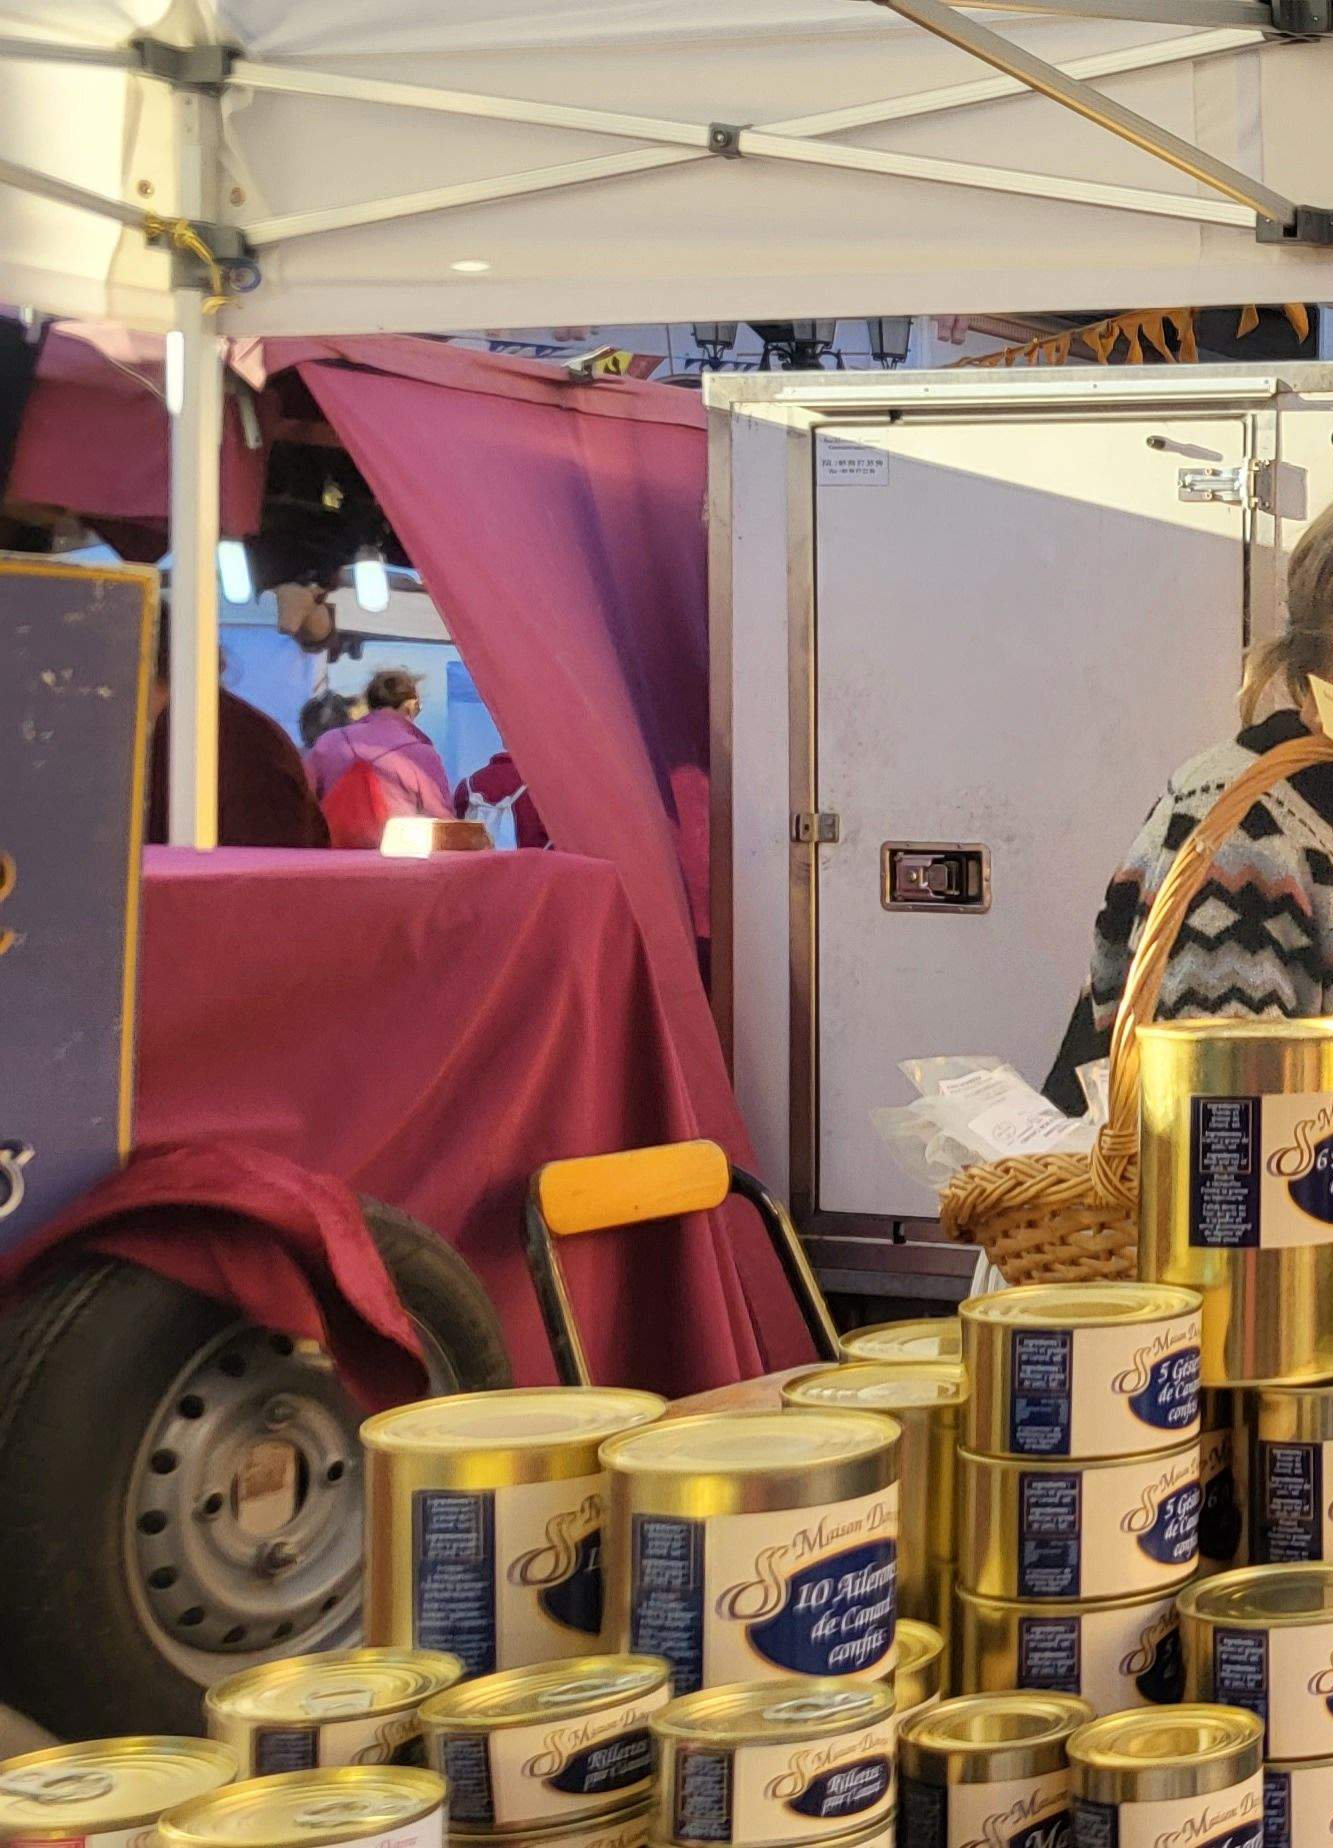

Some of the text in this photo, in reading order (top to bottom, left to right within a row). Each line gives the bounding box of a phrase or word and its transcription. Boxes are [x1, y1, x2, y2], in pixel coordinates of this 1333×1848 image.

[1316, 1147, 1330, 1171] 6
[1158, 1361, 1171, 1384] 5
[1159, 1381, 1174, 1405] de
[1164, 1496, 1177, 1521] 5
[793, 1514, 863, 1560] Maison
[1164, 1516, 1179, 1542] de
[792, 1577, 836, 1614] 10
[811, 1608, 841, 1644] de
